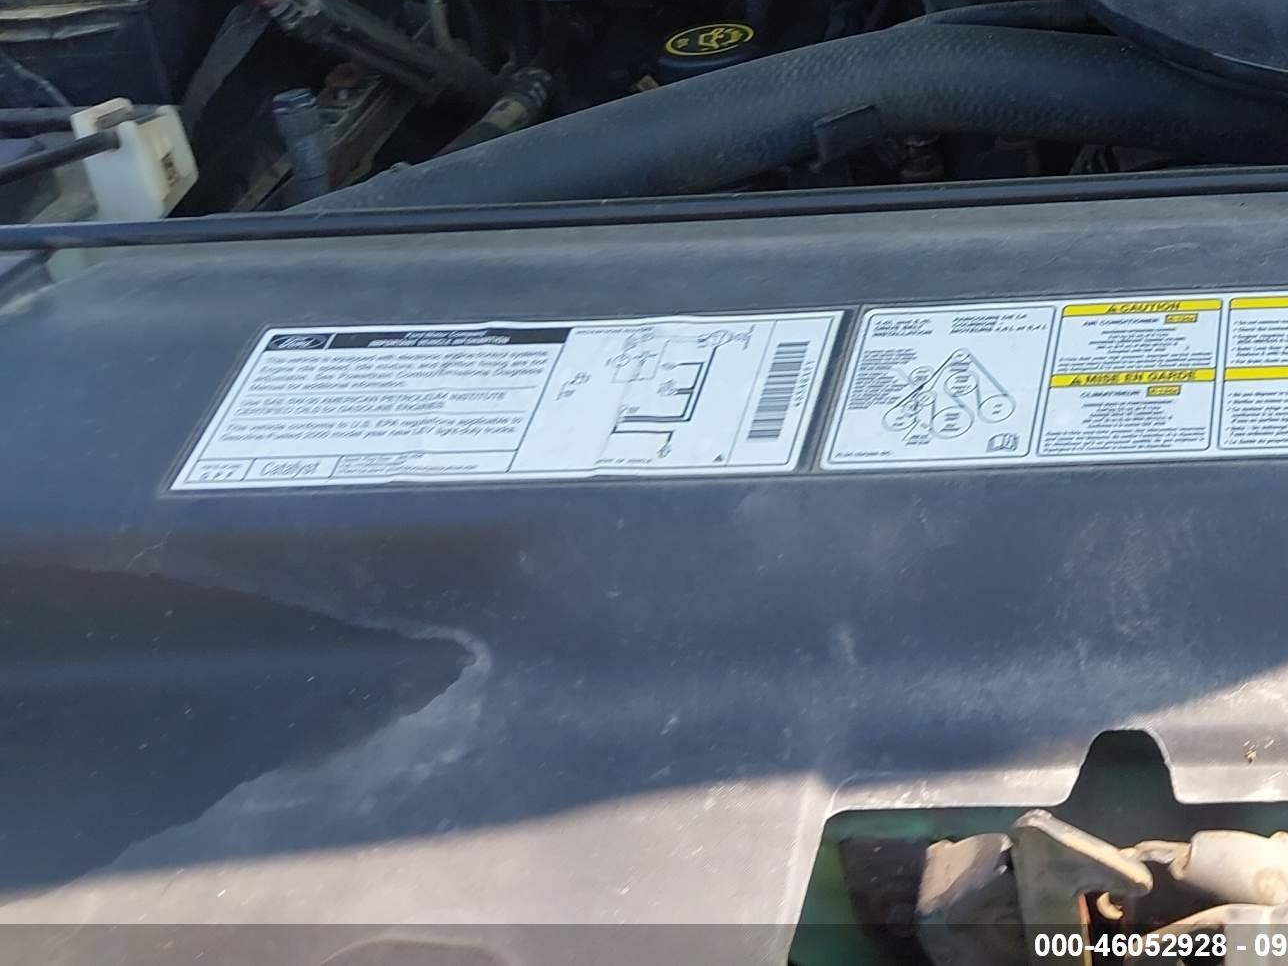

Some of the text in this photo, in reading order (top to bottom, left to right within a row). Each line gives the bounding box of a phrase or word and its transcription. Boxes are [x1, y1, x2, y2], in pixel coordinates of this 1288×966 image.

[1117, 302, 1181, 313] CAUTION
[1085, 374, 1120, 384] MISE
[1147, 370, 1196, 381] GARDE
[260, 462, 321, 479] Catalyst
